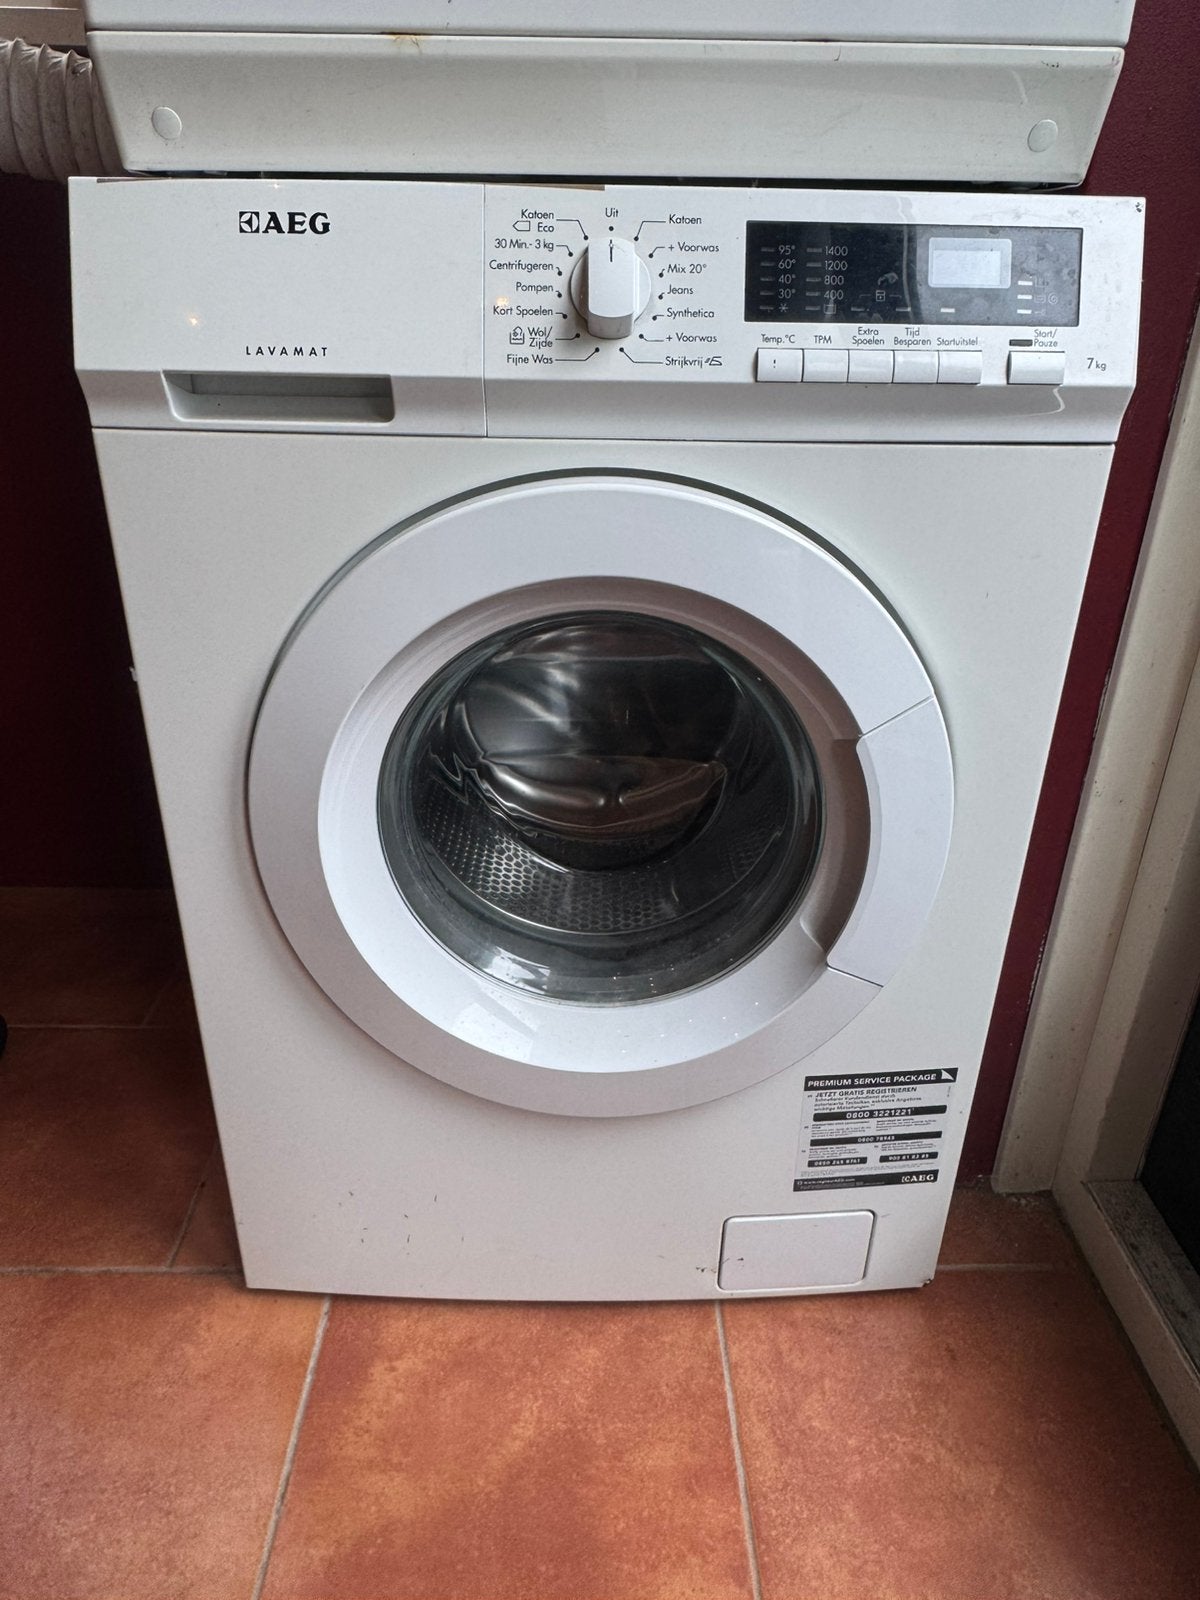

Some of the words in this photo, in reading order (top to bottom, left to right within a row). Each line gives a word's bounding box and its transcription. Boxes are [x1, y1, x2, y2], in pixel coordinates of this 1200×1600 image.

[521, 209, 554, 220] Katoen
[605, 208, 619, 218] Uit
[262, 211, 331, 235] AEG
[669, 214, 702, 224] Katoen
[537, 222, 555, 232] Eco
[495, 238, 507, 249] 30
[535, 239, 541, 249] 3
[543, 239, 554, 252] kg
[677, 242, 720, 252] Voorwas
[778, 245, 796, 256] 95°
[825, 246, 848, 256] 1400
[489, 260, 554, 273] Centrifugeren
[667, 264, 687, 274] Mix
[689, 264, 707, 274] 20°
[778, 259, 796, 269] 60°
[825, 260, 848, 270] 1200
[778, 274, 796, 284] 40°
[824, 275, 845, 285] 800
[516, 282, 553, 294] Pompen
[667, 284, 694, 295] Jeans
[778, 288, 796, 299] 30°
[824, 290, 844, 300] 400
[493, 306, 513, 316] Kort
[516, 306, 553, 318] Spoelen
[666, 307, 715, 319] Synthetica
[527, 326, 553, 340] Wol/
[858, 327, 879, 336] Extra
[905, 327, 920, 337] Tijd
[1034, 329, 1057, 338] Start/
[529, 338, 553, 349] Zijde
[676, 333, 717, 343] Voorwas
[814, 336, 832, 344] TPM
[852, 336, 885, 347] Spoelen
[894, 336, 932, 348] Besparen
[937, 337, 978, 347] Startuitstel
[1034, 339, 1058, 349] Pauze
[246, 346, 328, 357] LAVAMAT
[507, 354, 529, 366] Fijne
[532, 354, 553, 364] Was
[665, 356, 703, 369] Strijkvrij
[1086, 357, 1094, 369] 7
[1095, 360, 1107, 371] kg
[808, 1078, 852, 1088] PREMIUM
[854, 1076, 891, 1086] SERVICE
[893, 1073, 937, 1083] PACKAGE
[816, 1091, 838, 1099] JETZT
[839, 1089, 865, 1097] GRATIS
[866, 1086, 917, 1095] REGISTRIEREN
[846, 1111, 870, 1119] 0800
[873, 1108, 912, 1118] 3221221
[911, 1173, 934, 1183] AEG
